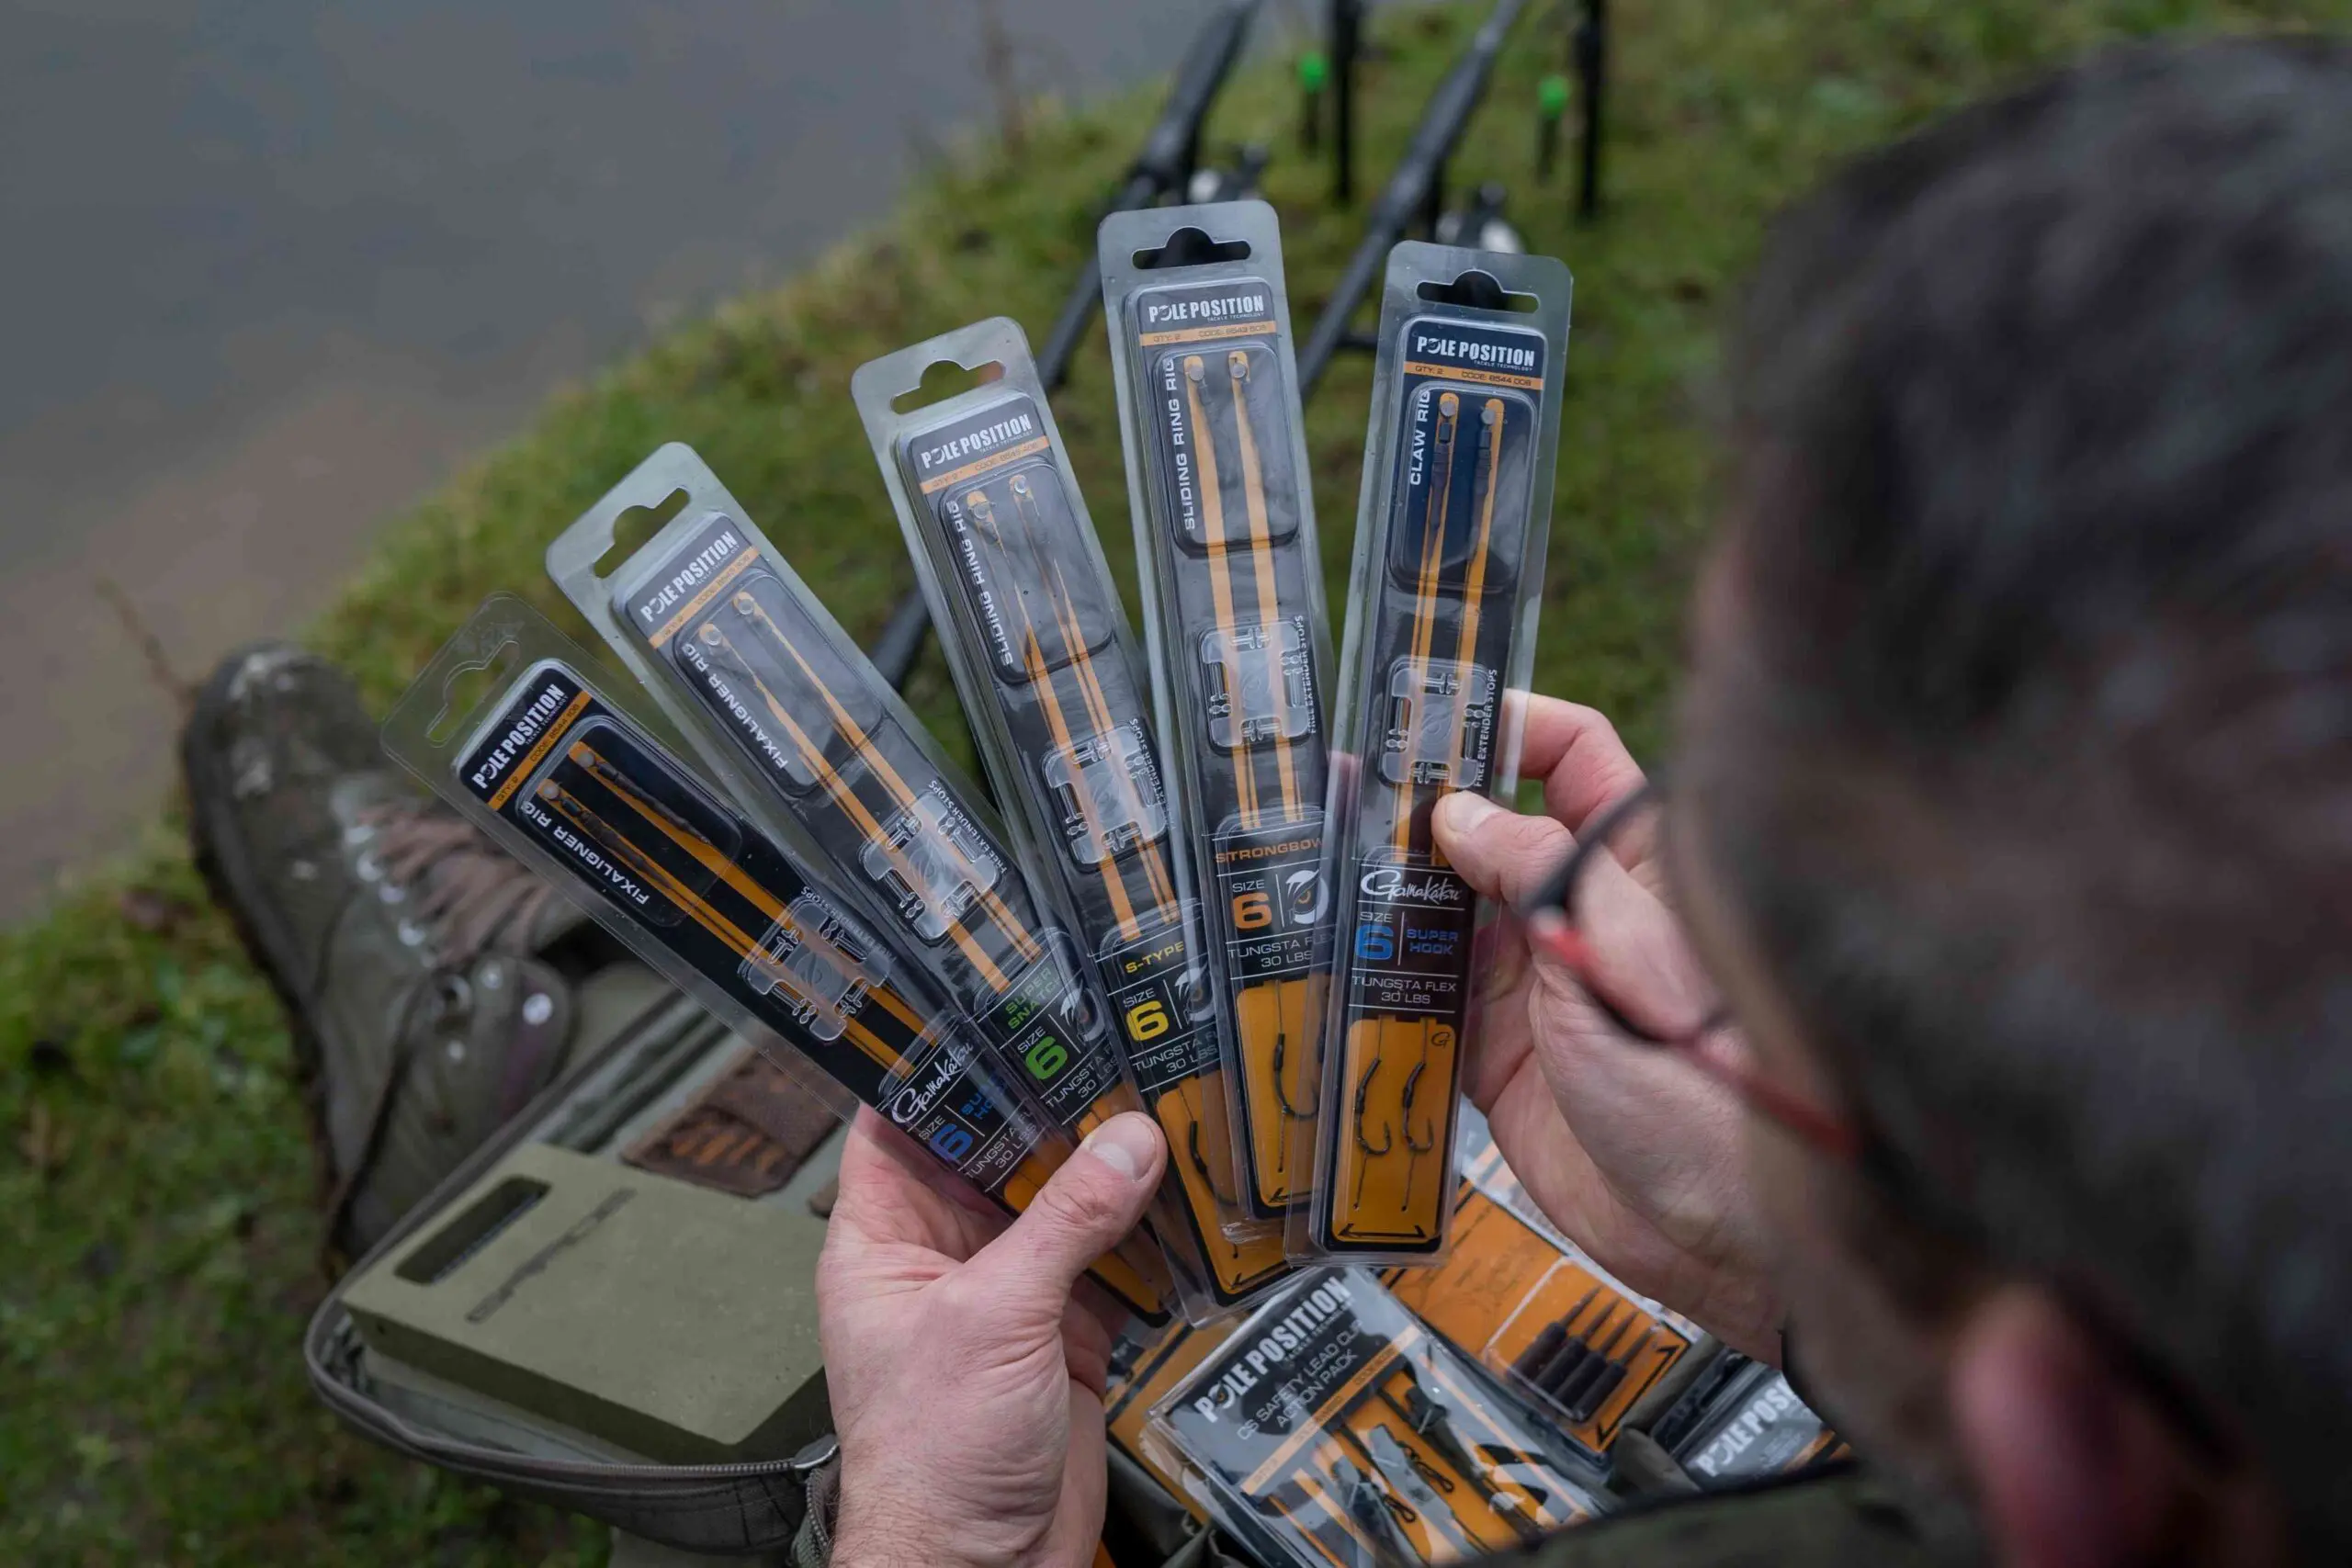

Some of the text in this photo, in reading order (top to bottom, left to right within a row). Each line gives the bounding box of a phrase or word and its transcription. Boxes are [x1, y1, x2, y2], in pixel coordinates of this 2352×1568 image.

[1148, 295, 1264, 321] POLE POSITION
[1416, 335, 1535, 367] POLE POSITION
[1497, 363, 1532, 371] TECHNOLOGY
[1461, 371, 1487, 380] CODE:
[920, 412, 1033, 469] POLE POSITION
[1161, 357, 1195, 530] SLIDING RING RIG
[1408, 389, 1430, 485] CLAW RIG
[639, 530, 740, 623] POLE POSITION
[944, 498, 1014, 666] SLIDING RING RIG
[1295, 615, 1307, 649] STOPS
[1297, 650, 1315, 706] EXTENDER
[679, 640, 790, 769] FIXALIGNER RIG
[469, 682, 568, 790] POLE POSITION
[525, 726, 543, 745] TACKLE
[1474, 669, 1498, 786] FREE EXTENDER STOPS
[528, 738, 551, 762] CODE:
[1129, 717, 1166, 805] EXTENDER STOPS
[928, 778, 1008, 874] FREE EXTENDER STOPS
[520, 799, 650, 905] FIXALIGNER RIG
[800, 885, 831, 911] STOPS
[1231, 878, 1265, 893] SIZE
[1361, 869, 1461, 903] Gamakatsu
[1234, 893, 1272, 929] 6
[1359, 910, 1393, 922] SIZE
[1227, 937, 1300, 960] TUNGSTA
[1356, 925, 1392, 960] 6
[1406, 928, 1458, 942] SUPER
[1408, 942, 1453, 954] HOOK
[1124, 940, 1187, 975] S-TYPE
[1261, 950, 1313, 967] 30 LBS
[1002, 966, 1054, 1015] SUPER
[1122, 987, 1156, 1009] SIZE
[1351, 975, 1456, 992] TUNGSTA FLEX
[1381, 991, 1430, 1004] 30 LBS
[1126, 1000, 1169, 1042] 6
[1015, 1024, 1046, 1055] SIZE
[1131, 1034, 1203, 1073] TUNGSTA
[1025, 1036, 1068, 1079] 6
[1165, 1043, 1217, 1073] 30 LBS
[1045, 1053, 1105, 1111] TUNGSTA
[1076, 1077, 1098, 1099] 30
[918, 1112, 945, 1142] SIZE
[930, 1123, 973, 1158] 6
[965, 1122, 1019, 1181] TUNGSTA
[994, 1122, 1038, 1169] 30 LBS
[1193, 1359, 1259, 1424] POLE
[1243, 1271, 1352, 1379] POSITION
[1235, 1416, 1261, 1442] CS
[1255, 1371, 1307, 1423] SAFETY
[1302, 1340, 1340, 1378] LEAD
[1273, 1379, 1324, 1428] ACTION
[1318, 1347, 1358, 1385] PACK
[1693, 1419, 1756, 1480] POLE
